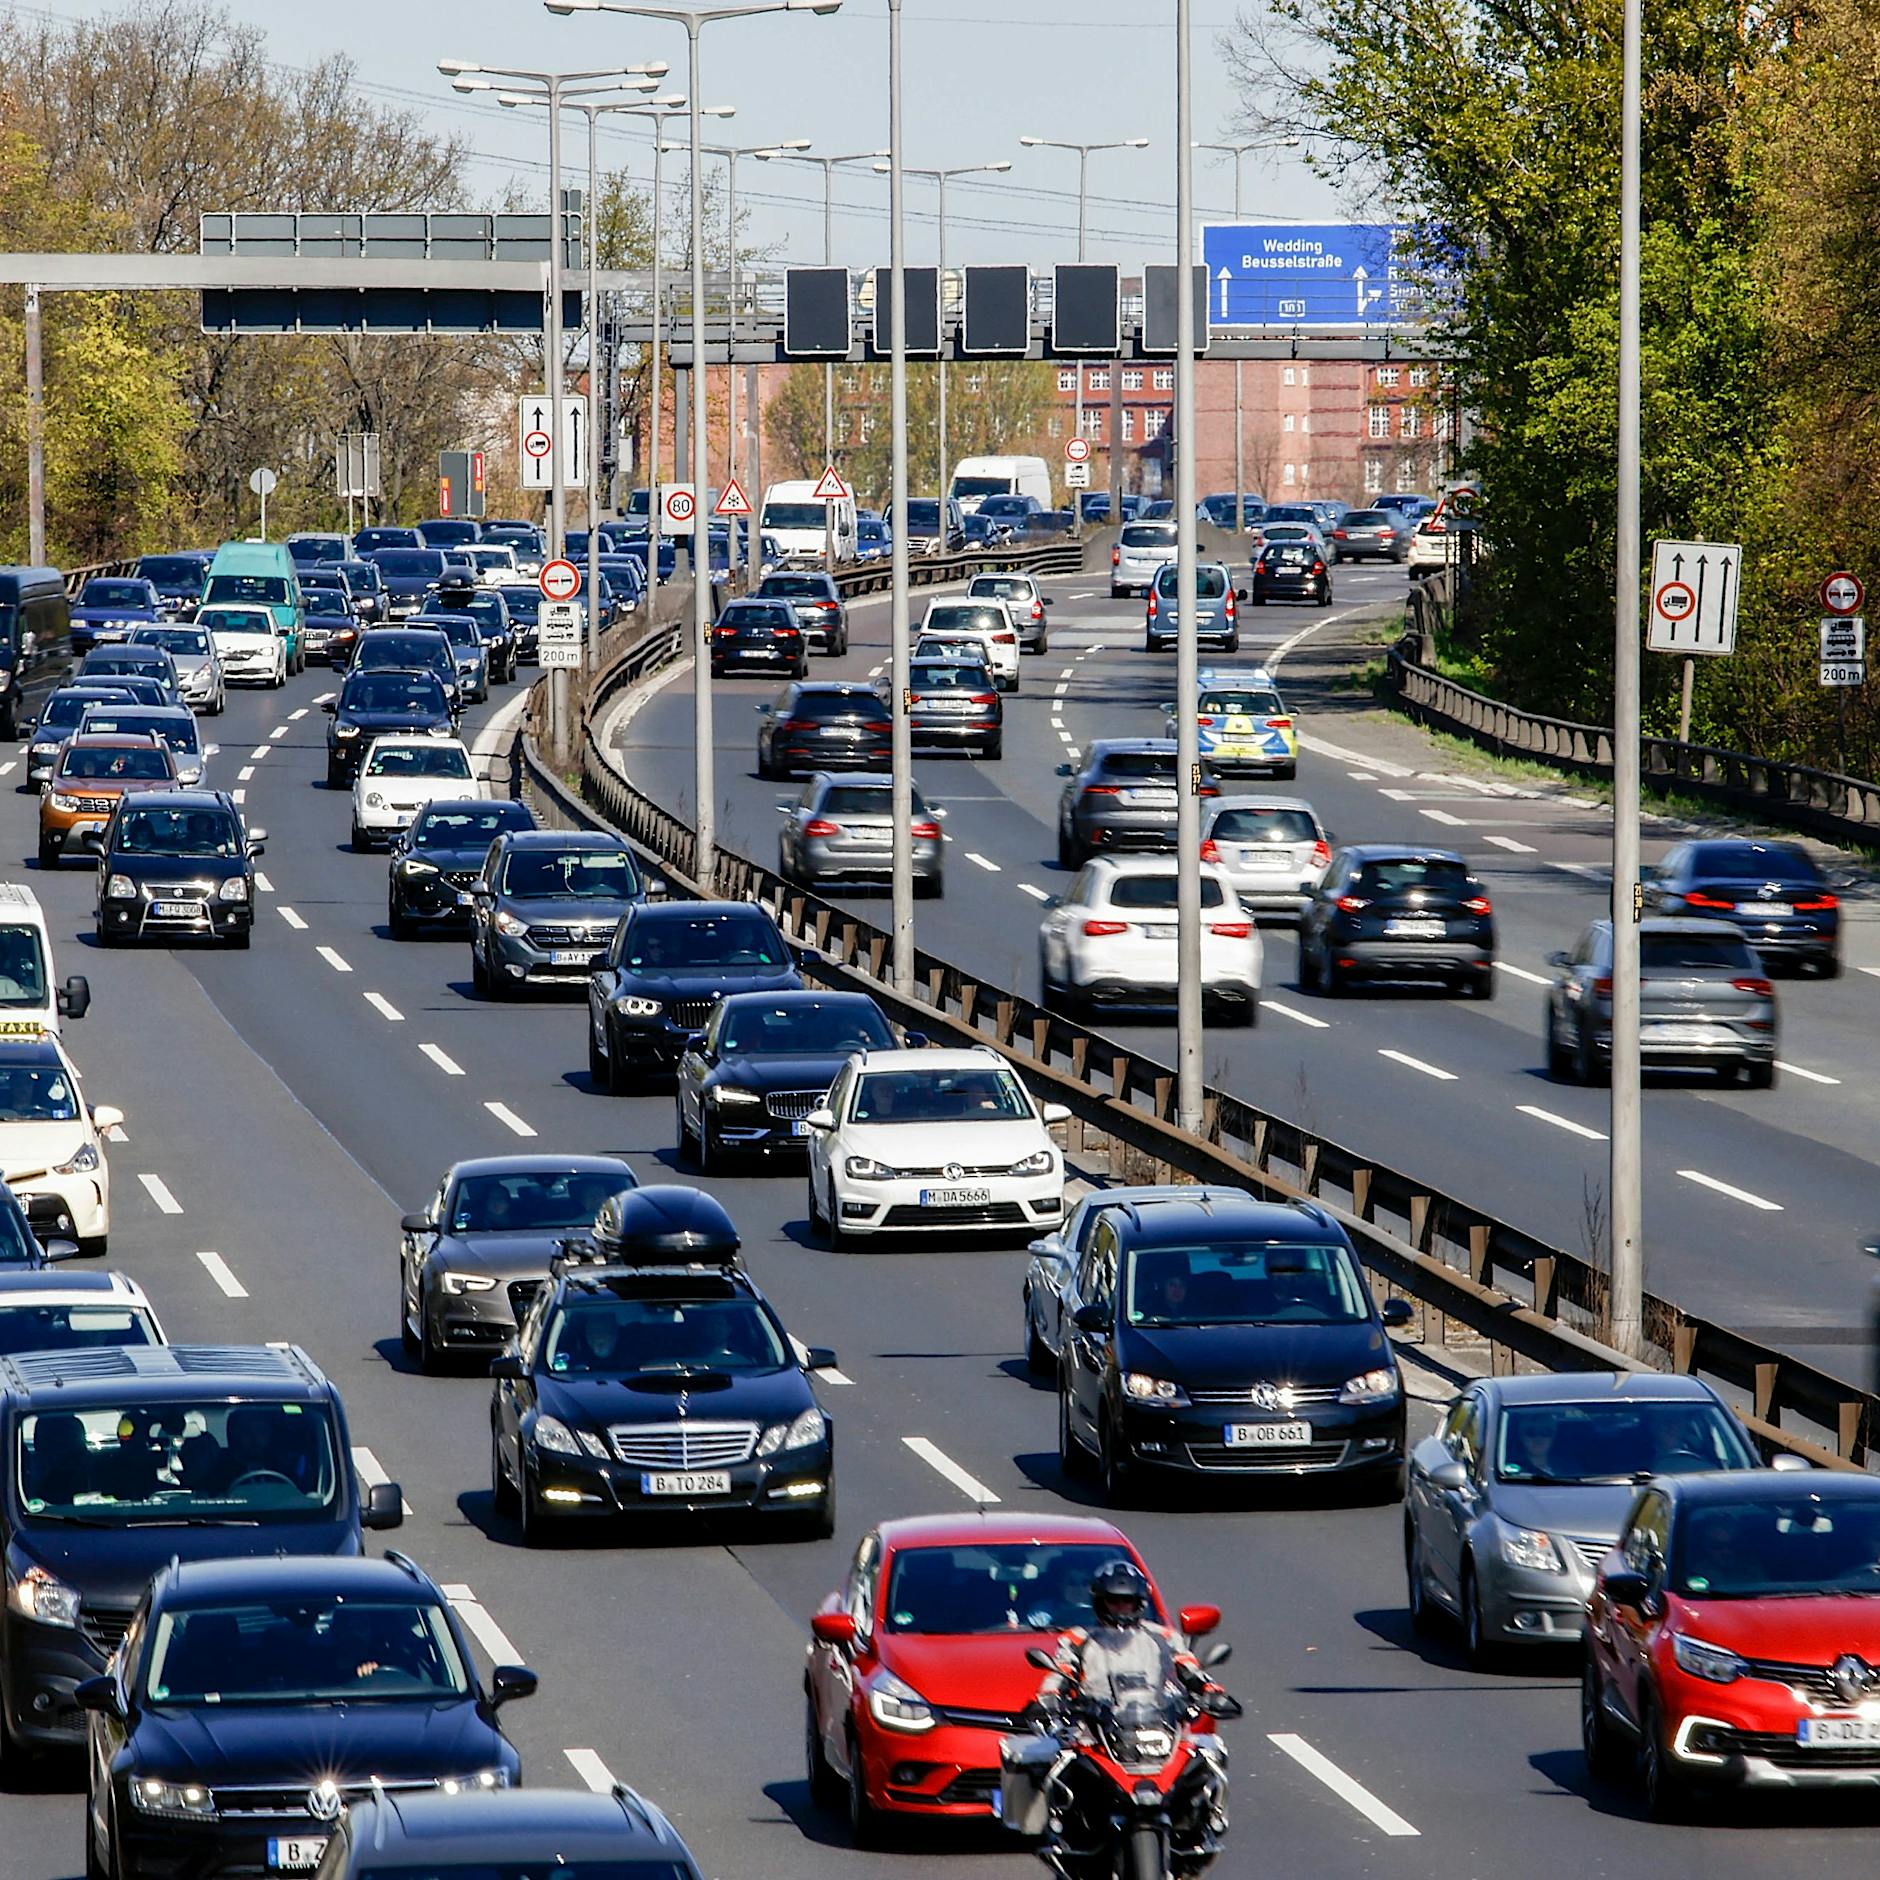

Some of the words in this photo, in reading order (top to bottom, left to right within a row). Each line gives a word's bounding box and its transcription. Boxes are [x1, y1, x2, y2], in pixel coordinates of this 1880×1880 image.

[1263, 239, 1323, 255] Wedding
[1242, 254, 1343, 268] Beusselstraße
[672, 499, 690, 513] 80
[543, 651, 565, 661] 200
[1823, 668, 1846, 680] 200
[1848, 671, 1860, 680] m
[569, 953, 579, 961] AY
[0, 1022, 34, 1033] TAXI
[800, 1124, 807, 1133] B
[928, 1191, 936, 1202] M
[1238, 1427, 1248, 1441] B
[1278, 1427, 1305, 1440] 661
[655, 1477, 666, 1491] B
[676, 1477, 695, 1491] TO
[698, 1475, 724, 1490] 284
[289, 1842, 300, 1861] B
